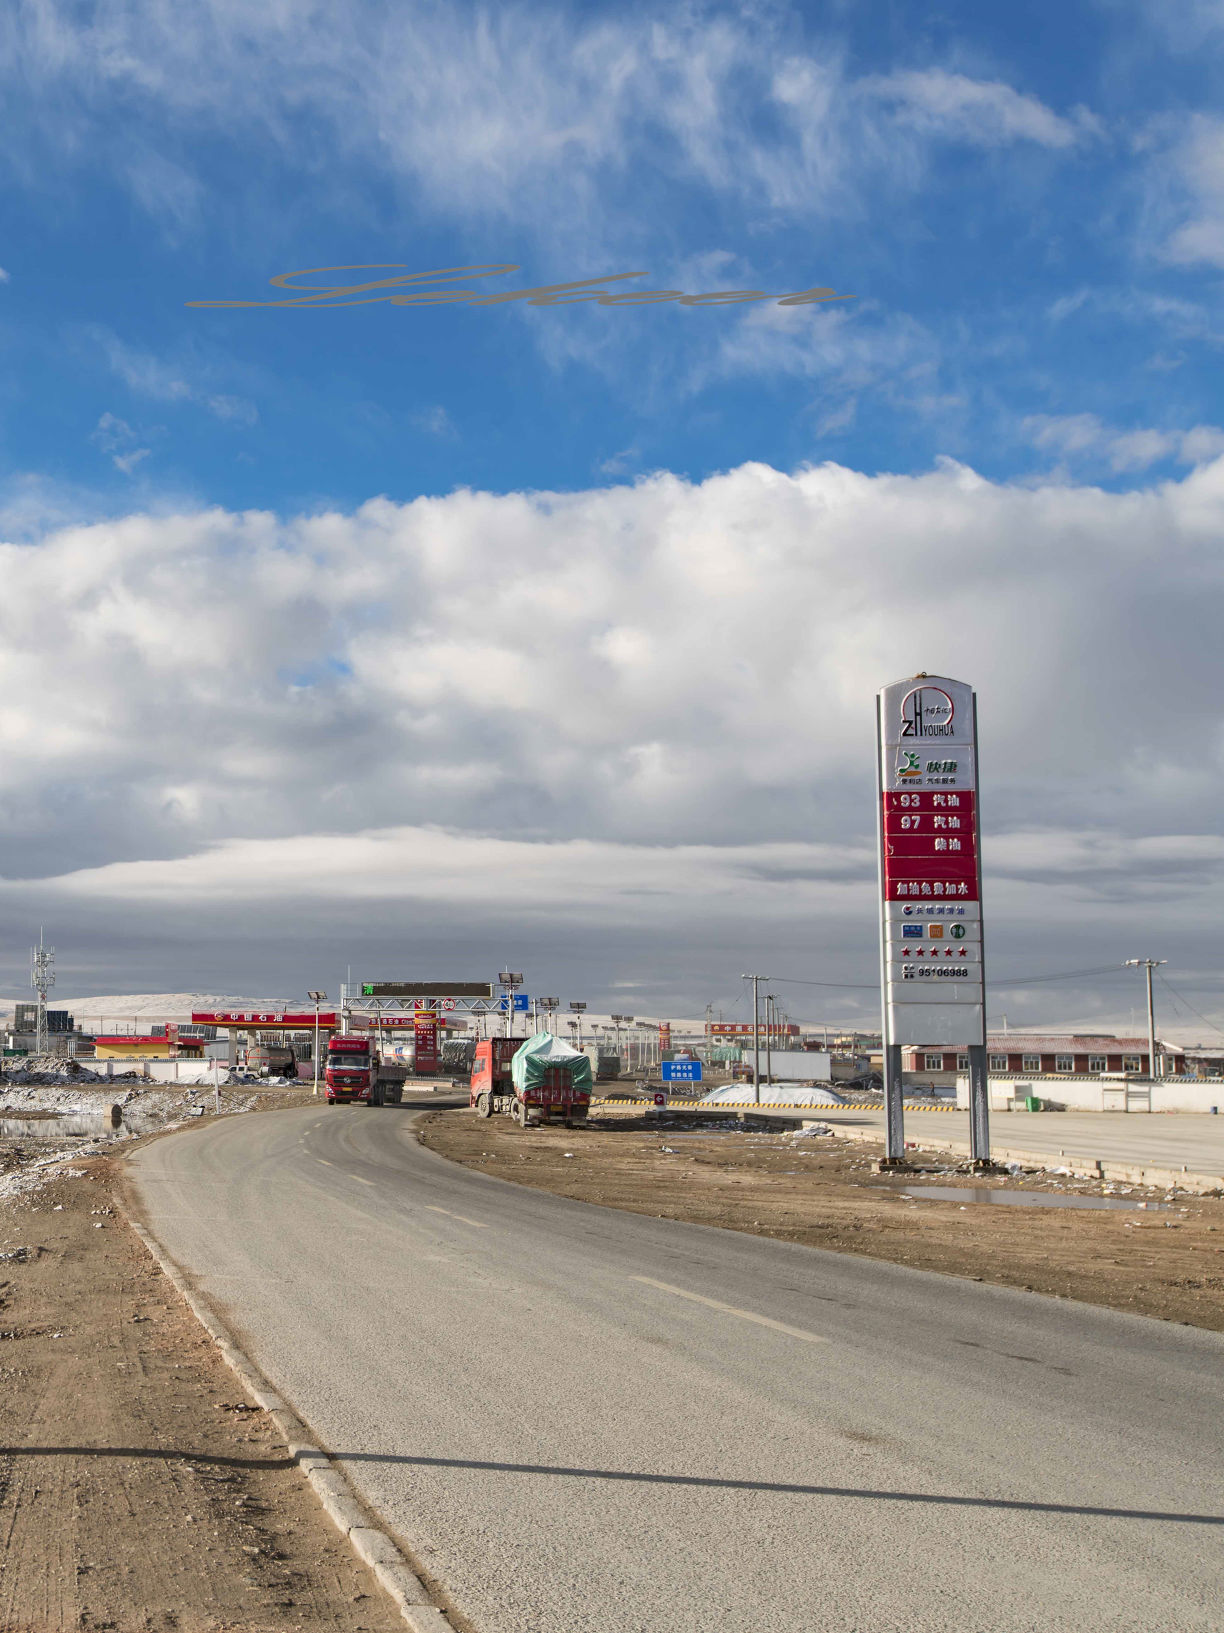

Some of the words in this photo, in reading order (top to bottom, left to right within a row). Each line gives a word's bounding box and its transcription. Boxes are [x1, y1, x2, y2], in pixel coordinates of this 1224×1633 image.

[900, 794, 921, 807] 93
[933, 794, 960, 807] 汽油
[901, 815, 921, 829] 97
[934, 815, 961, 829] 汽油
[934, 838, 961, 851] 柴油
[897, 881, 969, 896] 加油免费加水
[918, 968, 968, 977] 95106988
[231, 1013, 283, 1022] 中国石油
